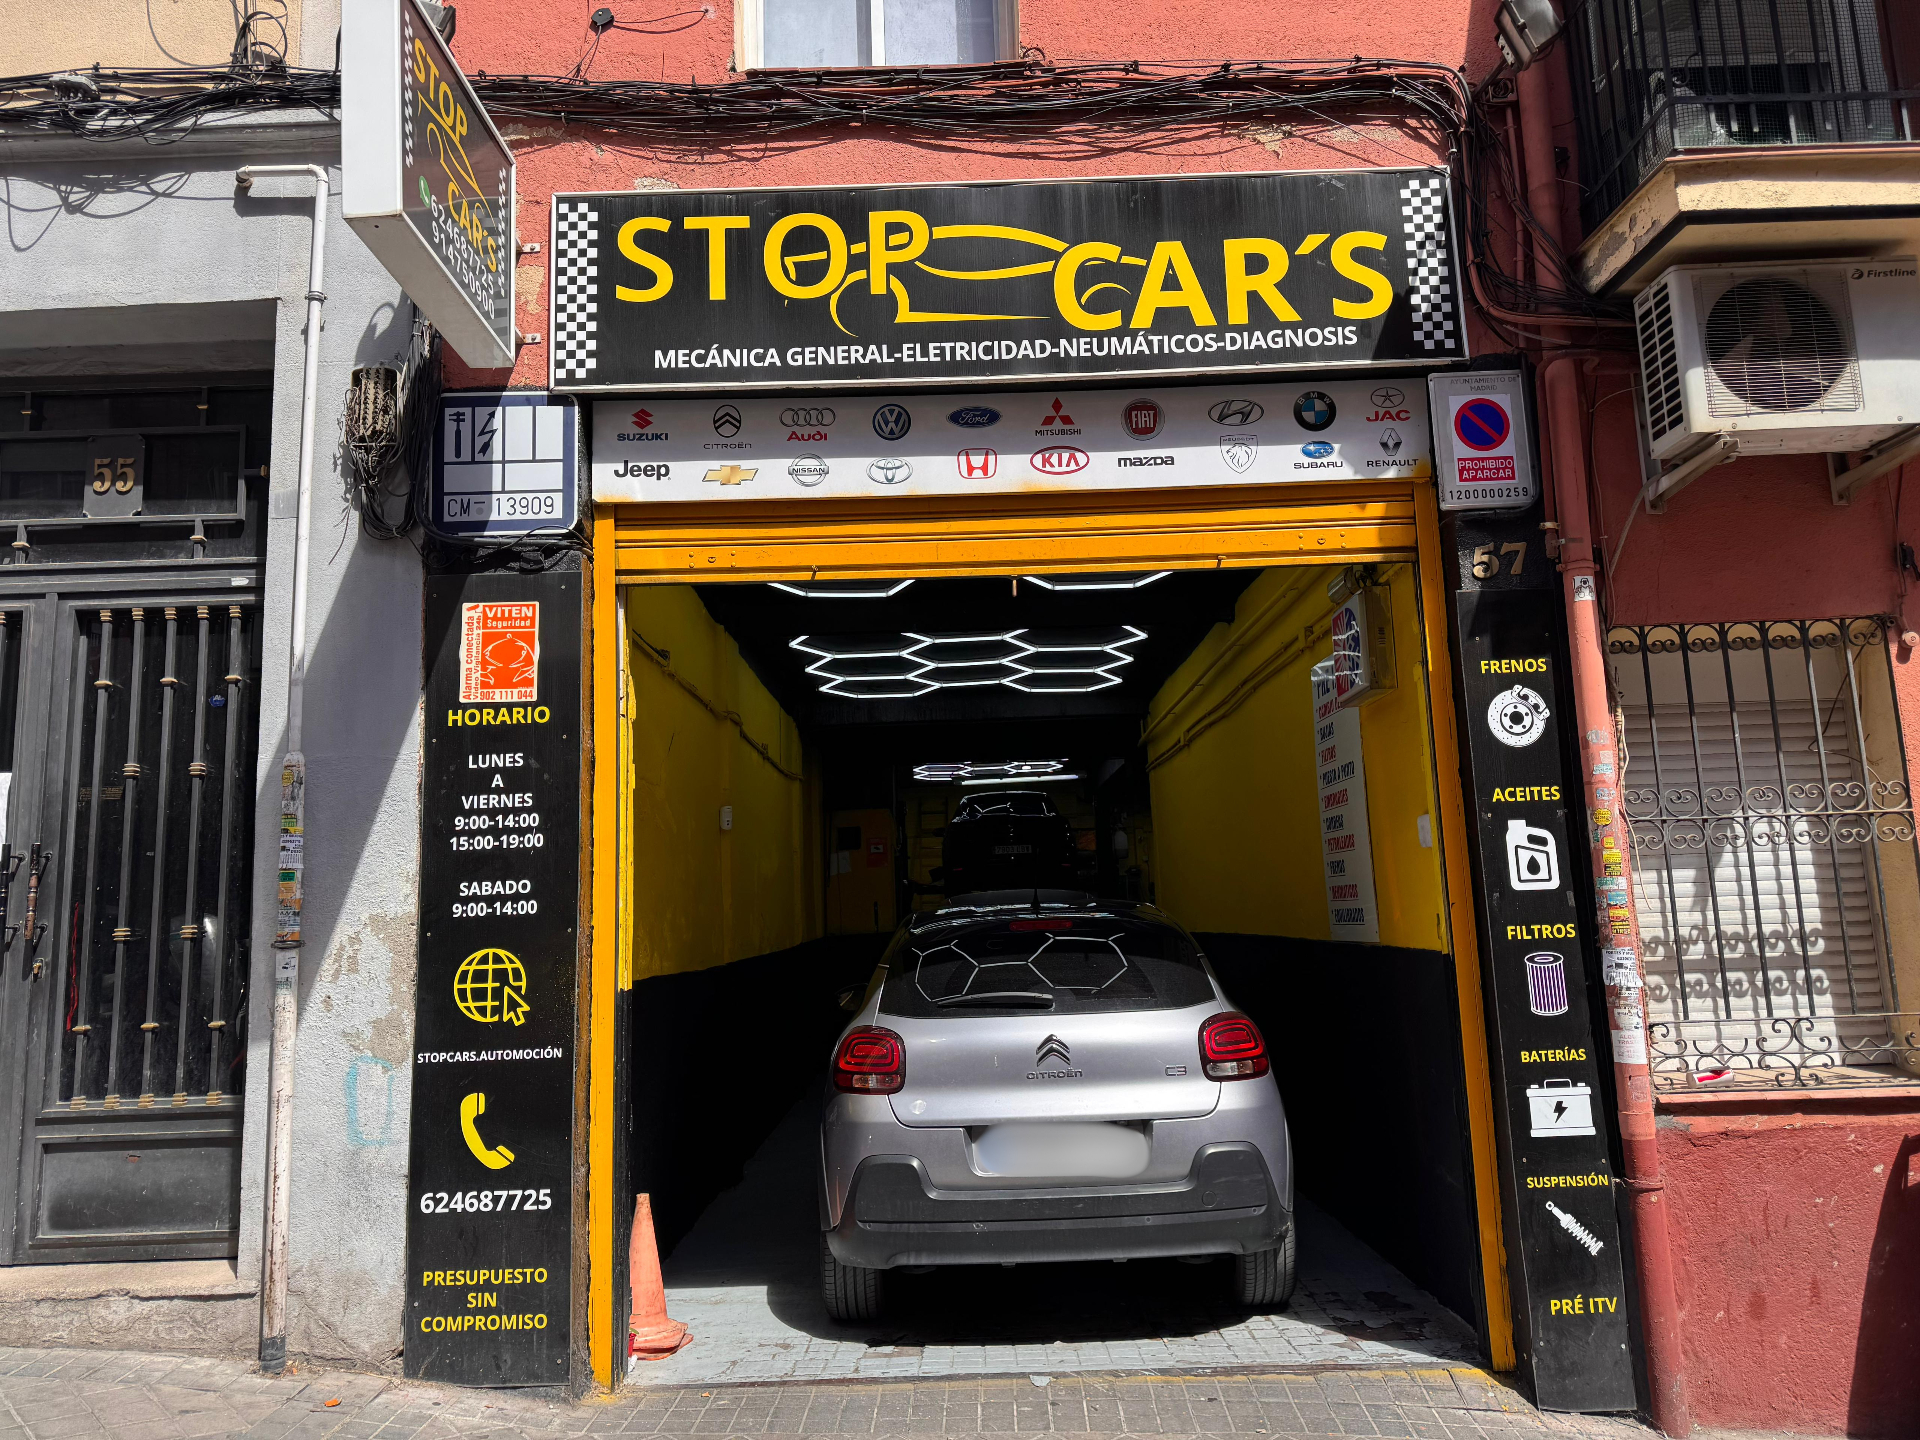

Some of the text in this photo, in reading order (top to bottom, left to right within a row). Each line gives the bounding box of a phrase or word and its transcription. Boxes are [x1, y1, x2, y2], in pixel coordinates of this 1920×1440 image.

[414, 37, 468, 143] STOP
[431, 194, 495, 295] 624687725
[615, 209, 930, 303] STOP
[432, 220, 495, 320] 914750900
[1866, 268, 1917, 278] Firstline
[653, 343, 781, 369] MECÁNICA
[1450, 376, 1506, 385] AYUNTAMIENTO
[1469, 384, 1498, 392] MADRID
[1297, 391, 1332, 405] BMW
[959, 410, 990, 424] Ford
[1132, 409, 1155, 428] FIAT
[1365, 409, 1411, 422] JAC
[616, 432, 669, 442] SUZUKI
[786, 430, 828, 442] Audi
[1034, 428, 1082, 437] MITSUBISHI
[1041, 452, 1081, 469] KIA
[1117, 455, 1175, 468] mazda
[1293, 460, 1344, 470] SUBARU
[1366, 458, 1419, 468] RENAULT
[1458, 459, 1514, 470] PROHIBIDO
[92, 457, 136, 493] 55
[613, 459, 671, 481] Jeep
[791, 466, 826, 475] NISSAN
[1462, 469, 1513, 479] APARCAR
[1449, 486, 1529, 500] 1200000259
[495, 495, 555, 517] 13909
[1472, 541, 1528, 579] 57
[484, 606, 533, 618] VITEN
[487, 619, 531, 628] Seguridad
[462, 615, 475, 701] Alarma conectada
[473, 632, 481, 676] Vigilancia
[1480, 658, 1547, 674] FRENOS
[480, 690, 534, 701] 902 111 044
[447, 705, 551, 727] HORARIO
[468, 752, 524, 769] LUNES
[491, 773, 505, 788] A
[461, 793, 533, 809] VIERNES
[1492, 785, 1561, 802] ACEITES
[454, 813, 540, 831] 9:00-14:00
[449, 833, 544, 851] 15:00-19:00
[459, 879, 532, 897] SABADO
[452, 900, 538, 917] 9:00-14:00
[1506, 923, 1576, 940] FILTROS
[417, 1045, 563, 1064] STOPCARS.AUTOMOCIÓN
[1520, 1047, 1587, 1063] BATERÍAS
[1165, 1065, 1187, 1077] C3
[1526, 1172, 1609, 1189] SUSPENSIÓN
[420, 1188, 552, 1214] 624687725
[422, 1268, 548, 1287] PRESUPUESTO
[467, 1292, 497, 1308] SIN
[1550, 1294, 1618, 1316] PRÉ ITV
[420, 1313, 548, 1332] COMPROMISO
